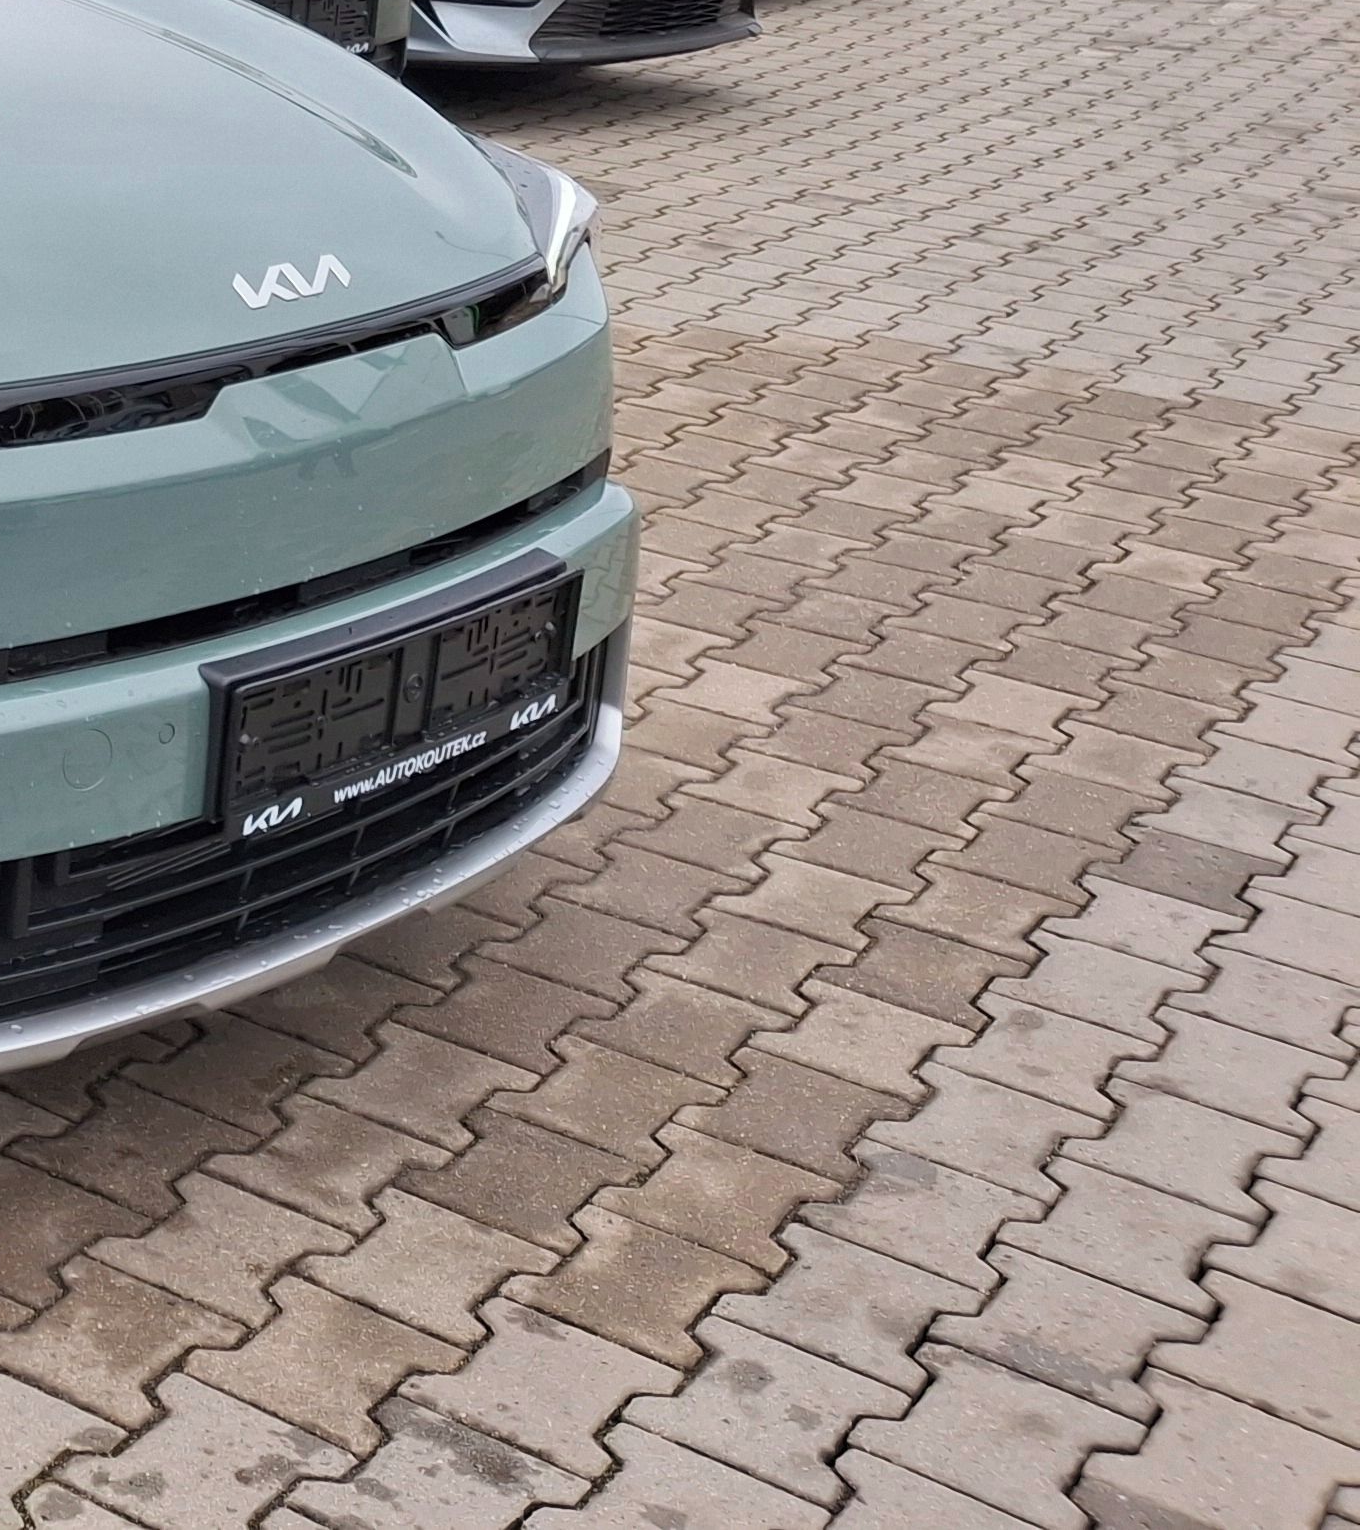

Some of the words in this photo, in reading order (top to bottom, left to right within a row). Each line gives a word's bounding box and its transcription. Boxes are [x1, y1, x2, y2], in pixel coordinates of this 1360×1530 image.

[232, 254, 351, 309] KIA
[508, 693, 559, 732] KIA
[333, 730, 487, 804] www.AUTOKOUTEK.cz
[241, 796, 303, 837] KIA
